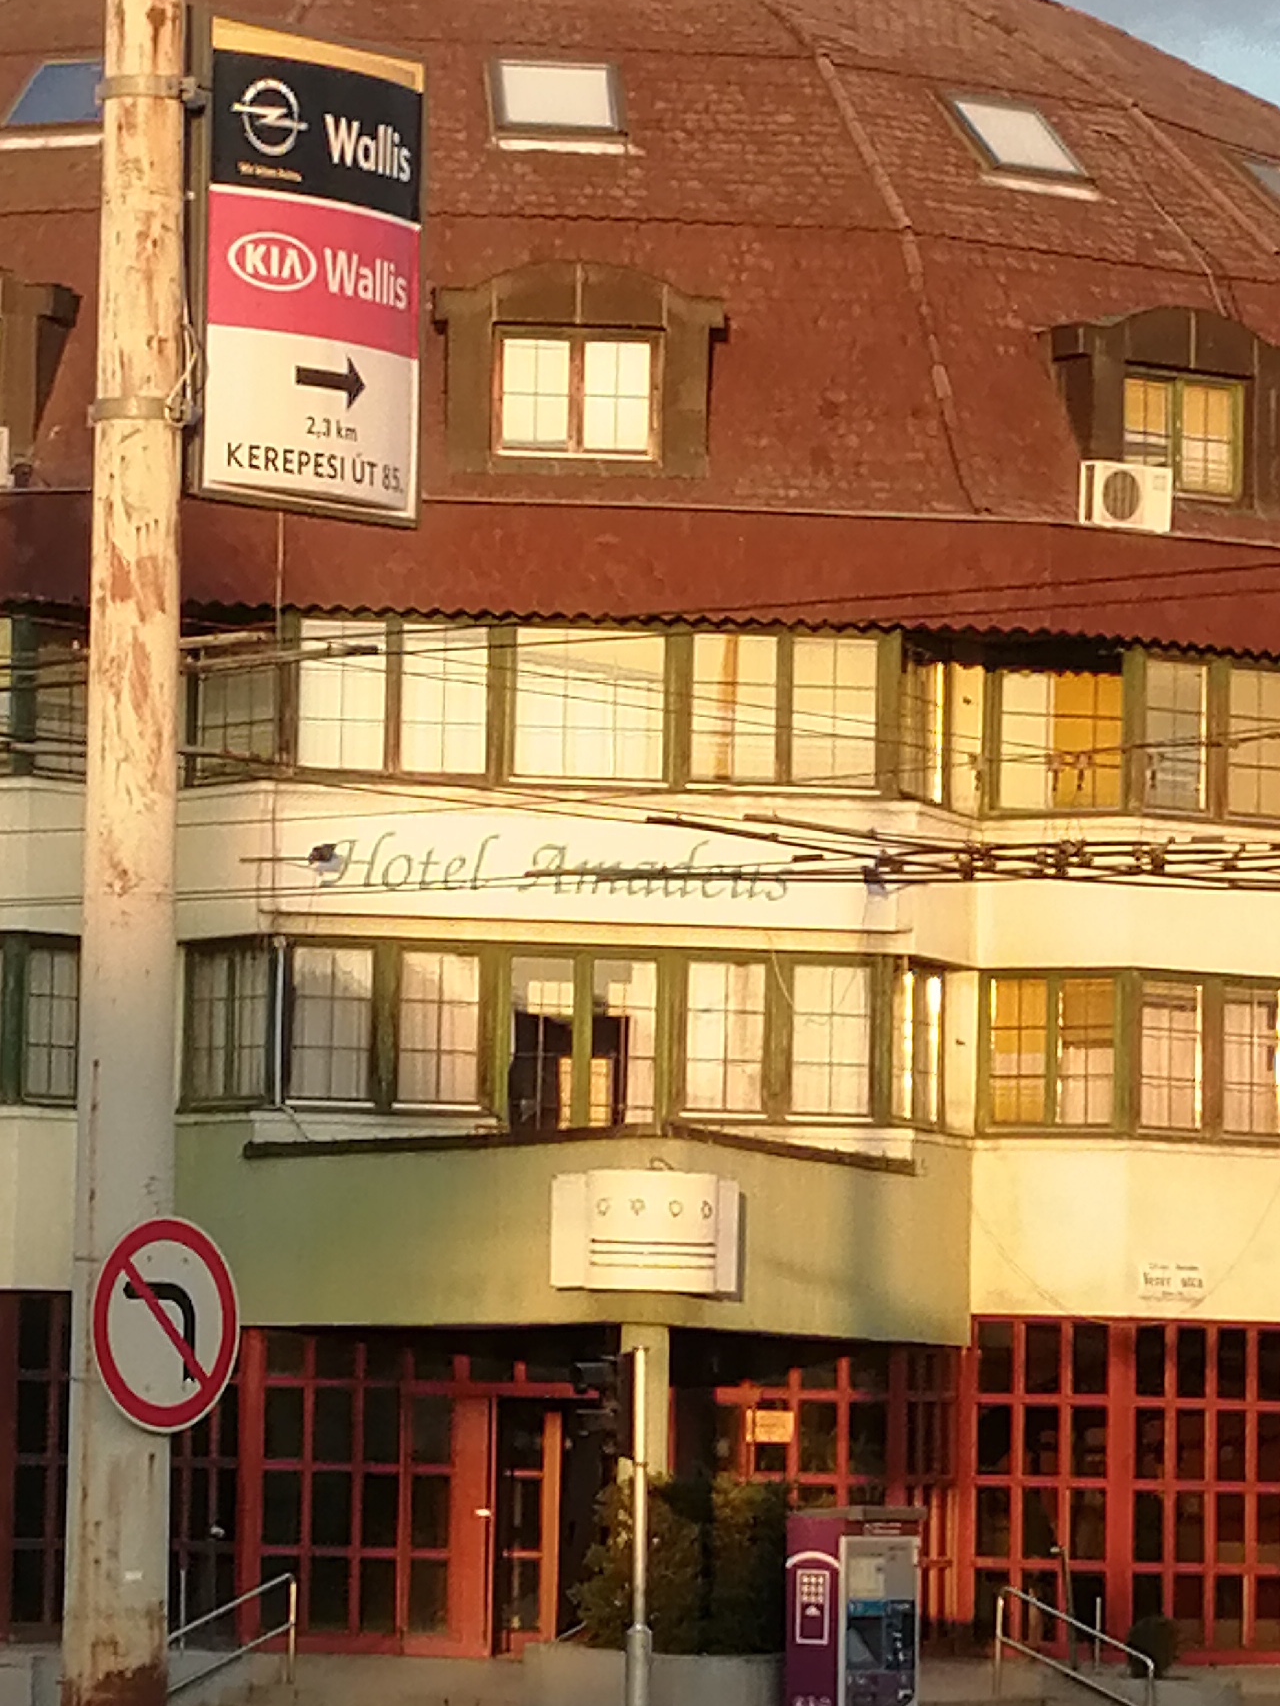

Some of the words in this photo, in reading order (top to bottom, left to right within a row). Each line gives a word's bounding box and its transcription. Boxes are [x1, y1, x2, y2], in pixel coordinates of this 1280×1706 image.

[324, 111, 411, 184] Wallis
[243, 241, 304, 283] KIA
[323, 245, 408, 312] Wallis
[226, 440, 346, 482] KEREPESI
[350, 450, 377, 487] ÚT
[333, 418, 358, 443] km
[322, 831, 500, 892] Hotel
[521, 840, 795, 902] Amadeus
